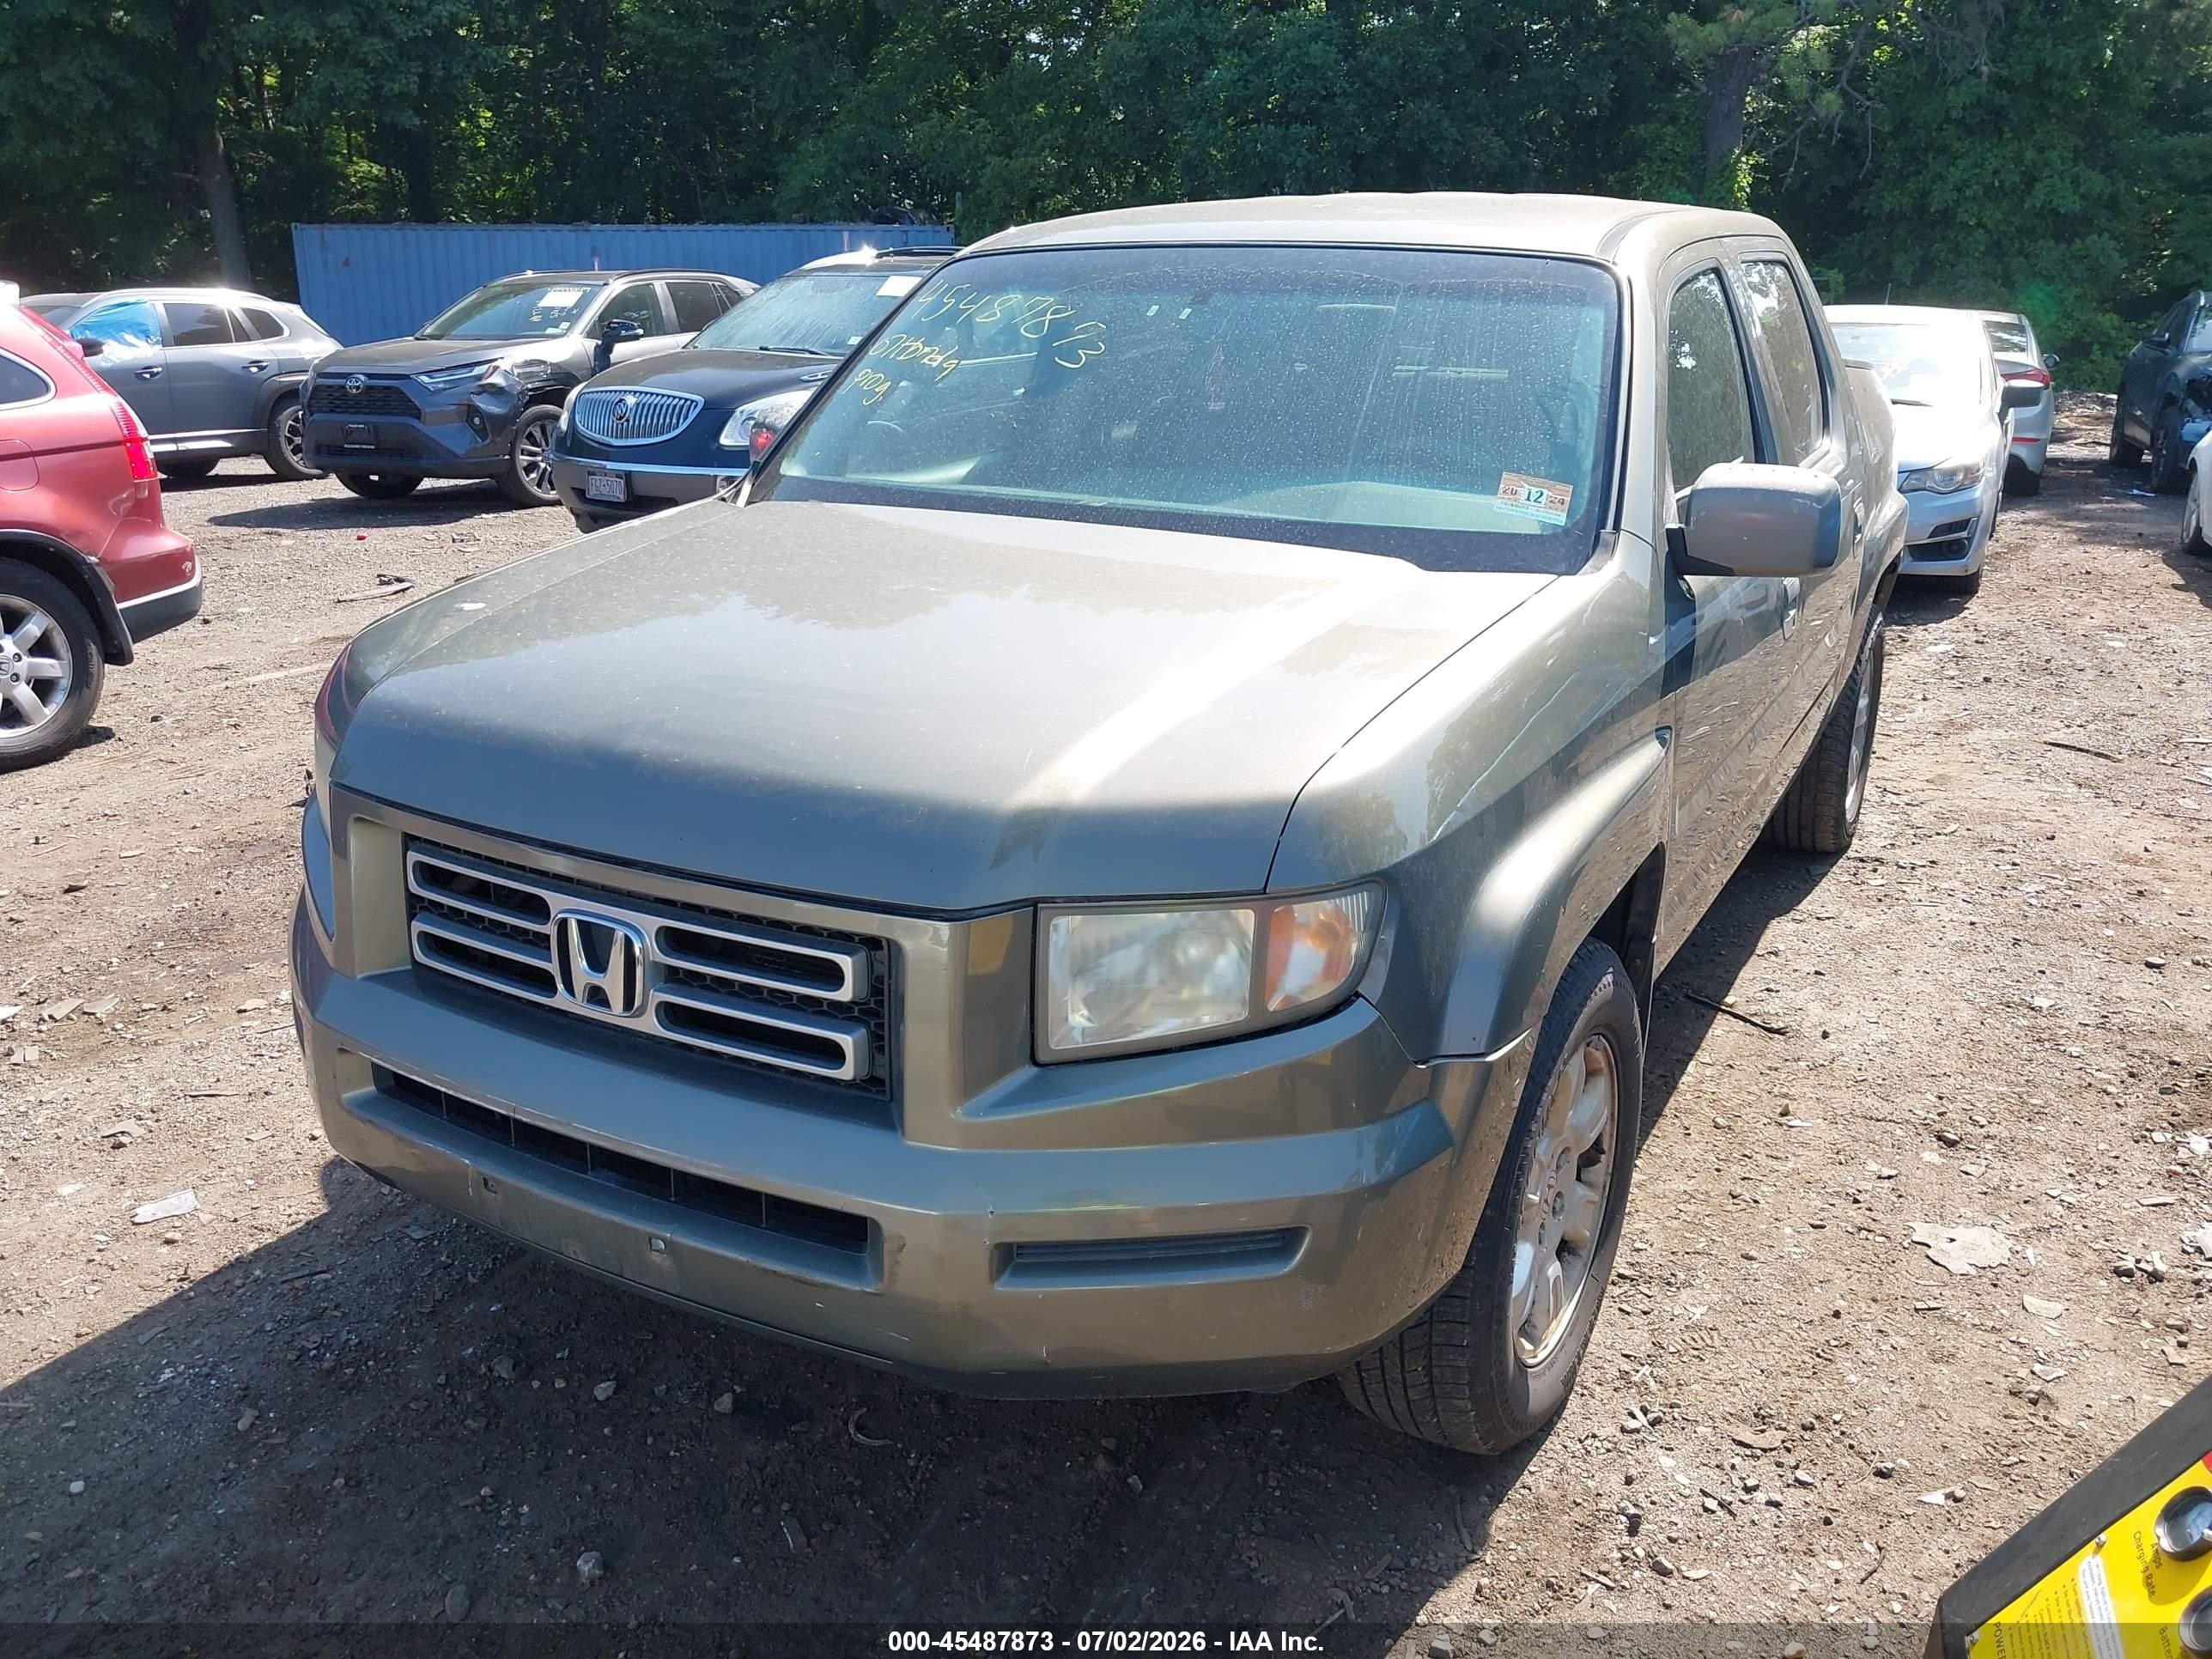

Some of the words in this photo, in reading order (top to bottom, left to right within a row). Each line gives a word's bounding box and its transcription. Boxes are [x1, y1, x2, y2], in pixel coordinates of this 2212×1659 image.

[1525, 489, 1544, 504] 12
[2133, 1530, 2149, 1574] Charging
[2145, 1572, 2156, 1598] Rate
[2150, 1542, 2163, 1570] Amps
[1992, 1620, 2007, 1659] POWE
